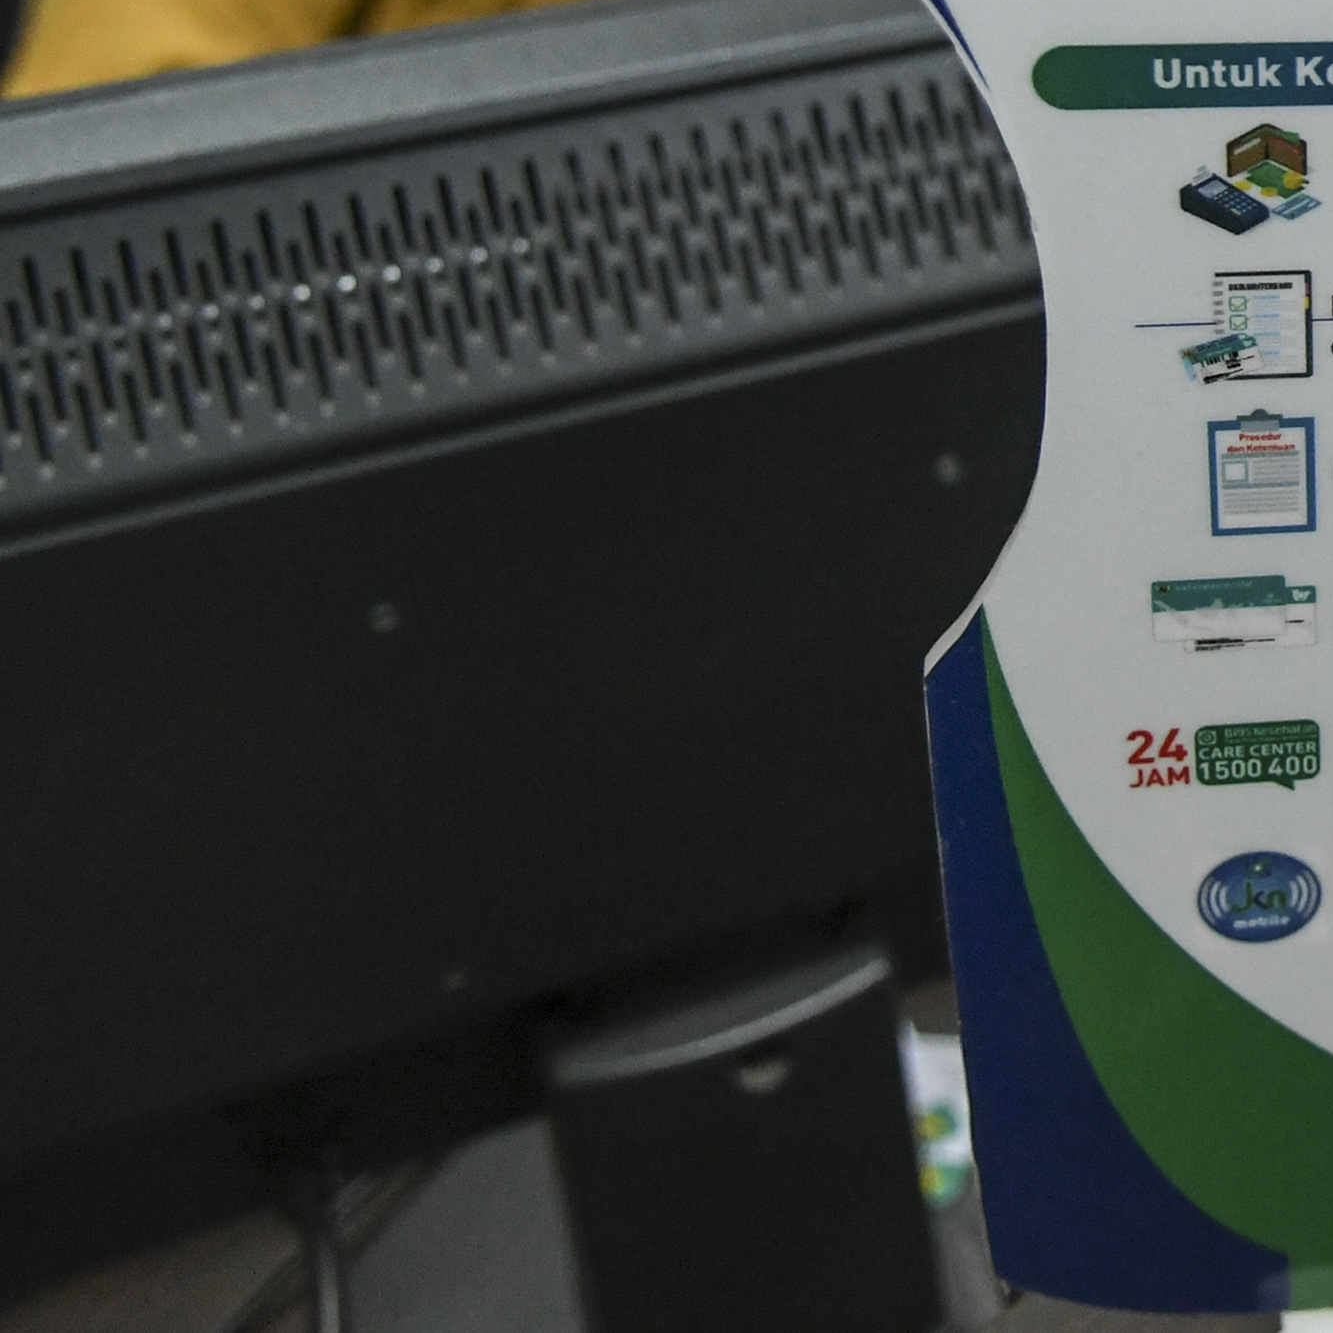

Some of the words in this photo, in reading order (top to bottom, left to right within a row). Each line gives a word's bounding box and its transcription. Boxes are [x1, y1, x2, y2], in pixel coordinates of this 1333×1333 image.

[1154, 57, 1282, 89] Untuk
[1126, 728, 1188, 764] 24
[1199, 746, 1245, 760] CARE
[1250, 741, 1317, 757] CENTER
[1129, 766, 1191, 788] JAM
[1200, 759, 1262, 780] 1500
[1267, 755, 1317, 776] 400
